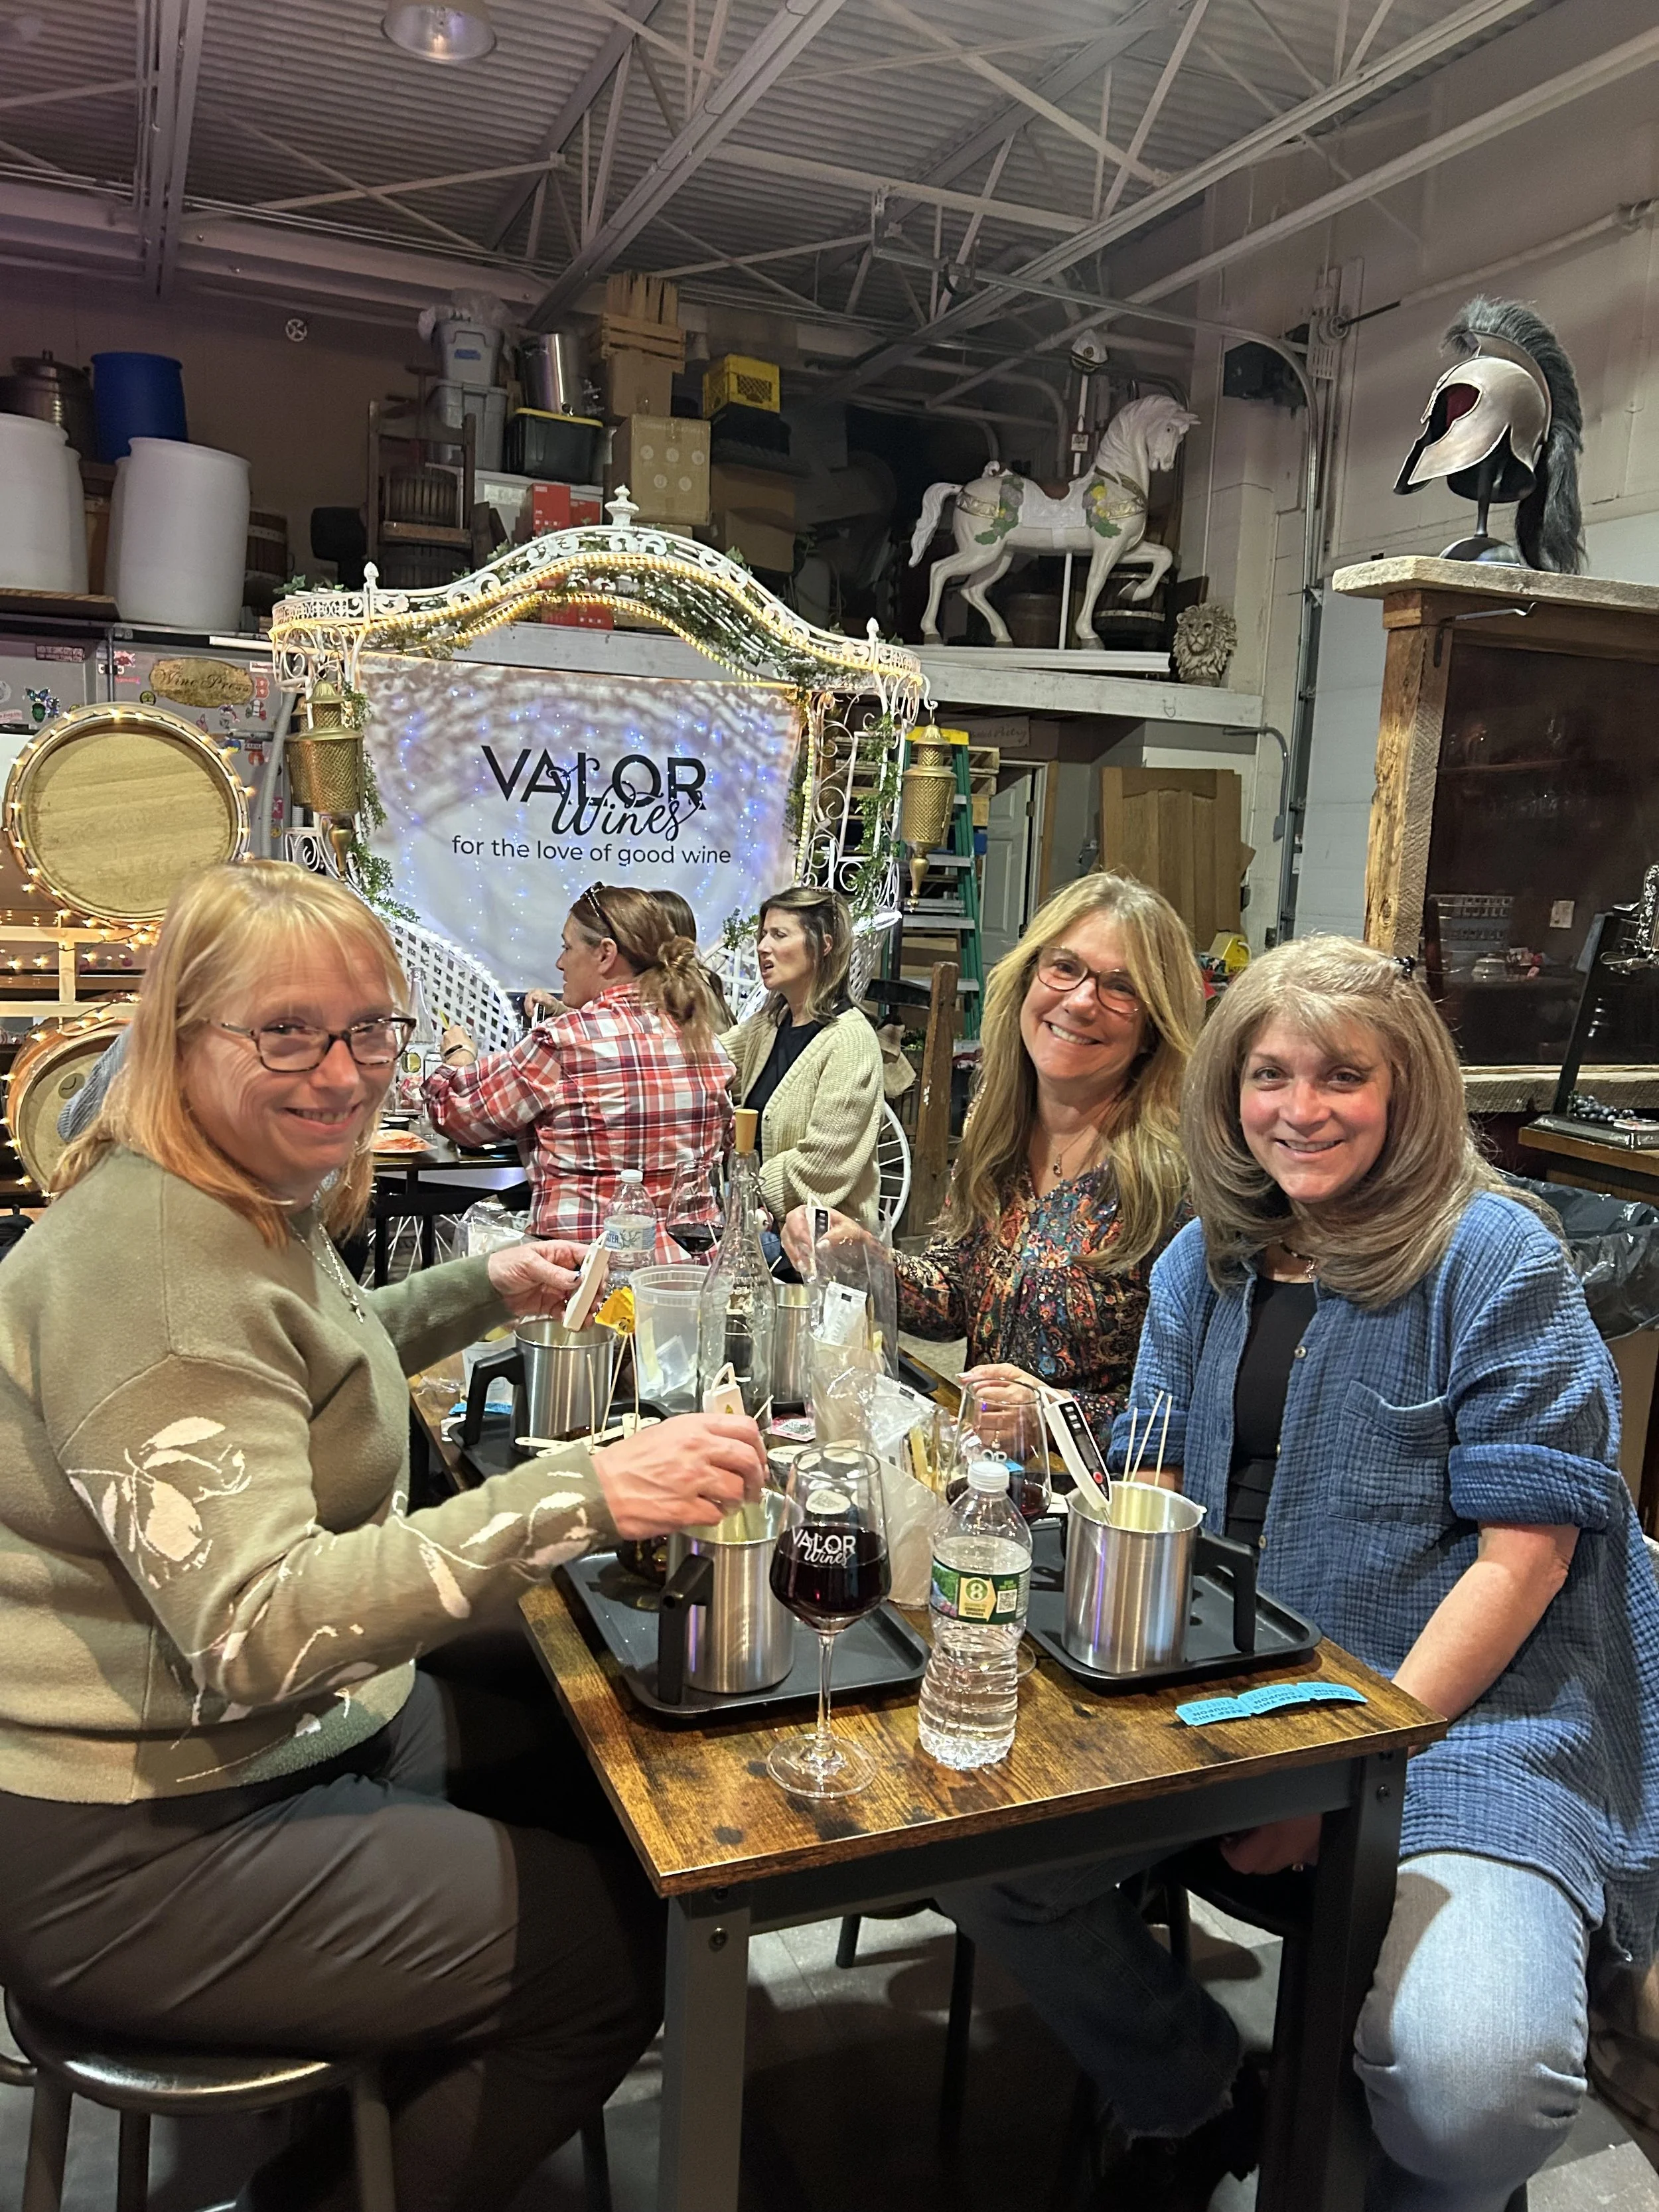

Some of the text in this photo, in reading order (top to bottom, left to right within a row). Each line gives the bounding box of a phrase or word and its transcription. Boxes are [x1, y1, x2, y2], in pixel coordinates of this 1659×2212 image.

[152, 669, 250, 692] Wine Press
[480, 745, 707, 810] VALOR
[547, 760, 703, 842] Wines
[452, 836, 731, 866] for the love of good wine
[791, 1525, 856, 1554] VALOR
[804, 1536, 853, 1566] Wines
[1192, 1706, 1235, 1717] COUPON
[1254, 1691, 1295, 1705] COUPON
[1192, 1713, 1216, 1722] THIS
